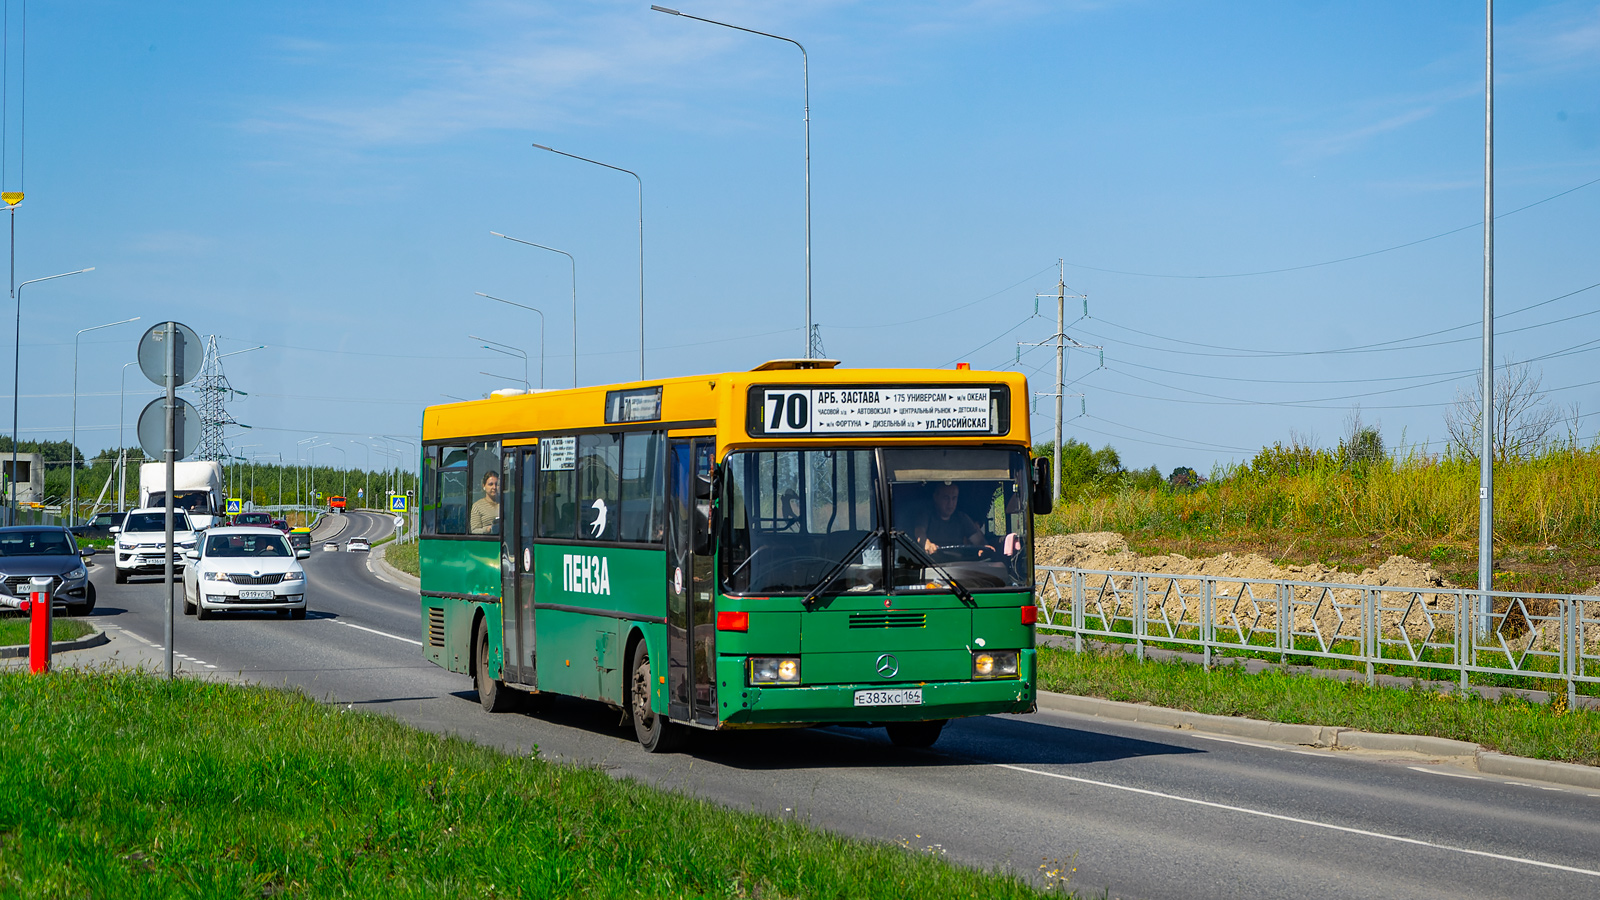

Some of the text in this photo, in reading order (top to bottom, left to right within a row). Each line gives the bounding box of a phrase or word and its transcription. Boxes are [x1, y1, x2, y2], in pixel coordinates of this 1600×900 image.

[818, 391, 838, 404] АРБ.
[841, 391, 880, 404] ЗАСТАВА
[894, 393, 906, 402] 175
[907, 393, 947, 402] УНИВЕРСАМ
[967, 393, 987, 401] ОКЕАН
[767, 393, 808, 429] 70
[818, 407, 839, 415] ЧАСОВОЙ
[857, 407, 891, 415] АВТОВОКЗАЛ
[899, 406, 934, 414] ЦЕНТРАЛЬНЫЙ
[872, 419, 906, 428] ДИЗЕЛЬНЫЙ
[542, 440, 550, 469] 70
[563, 554, 611, 596] ПЕНЗА
[903, 691, 920, 700] 164
